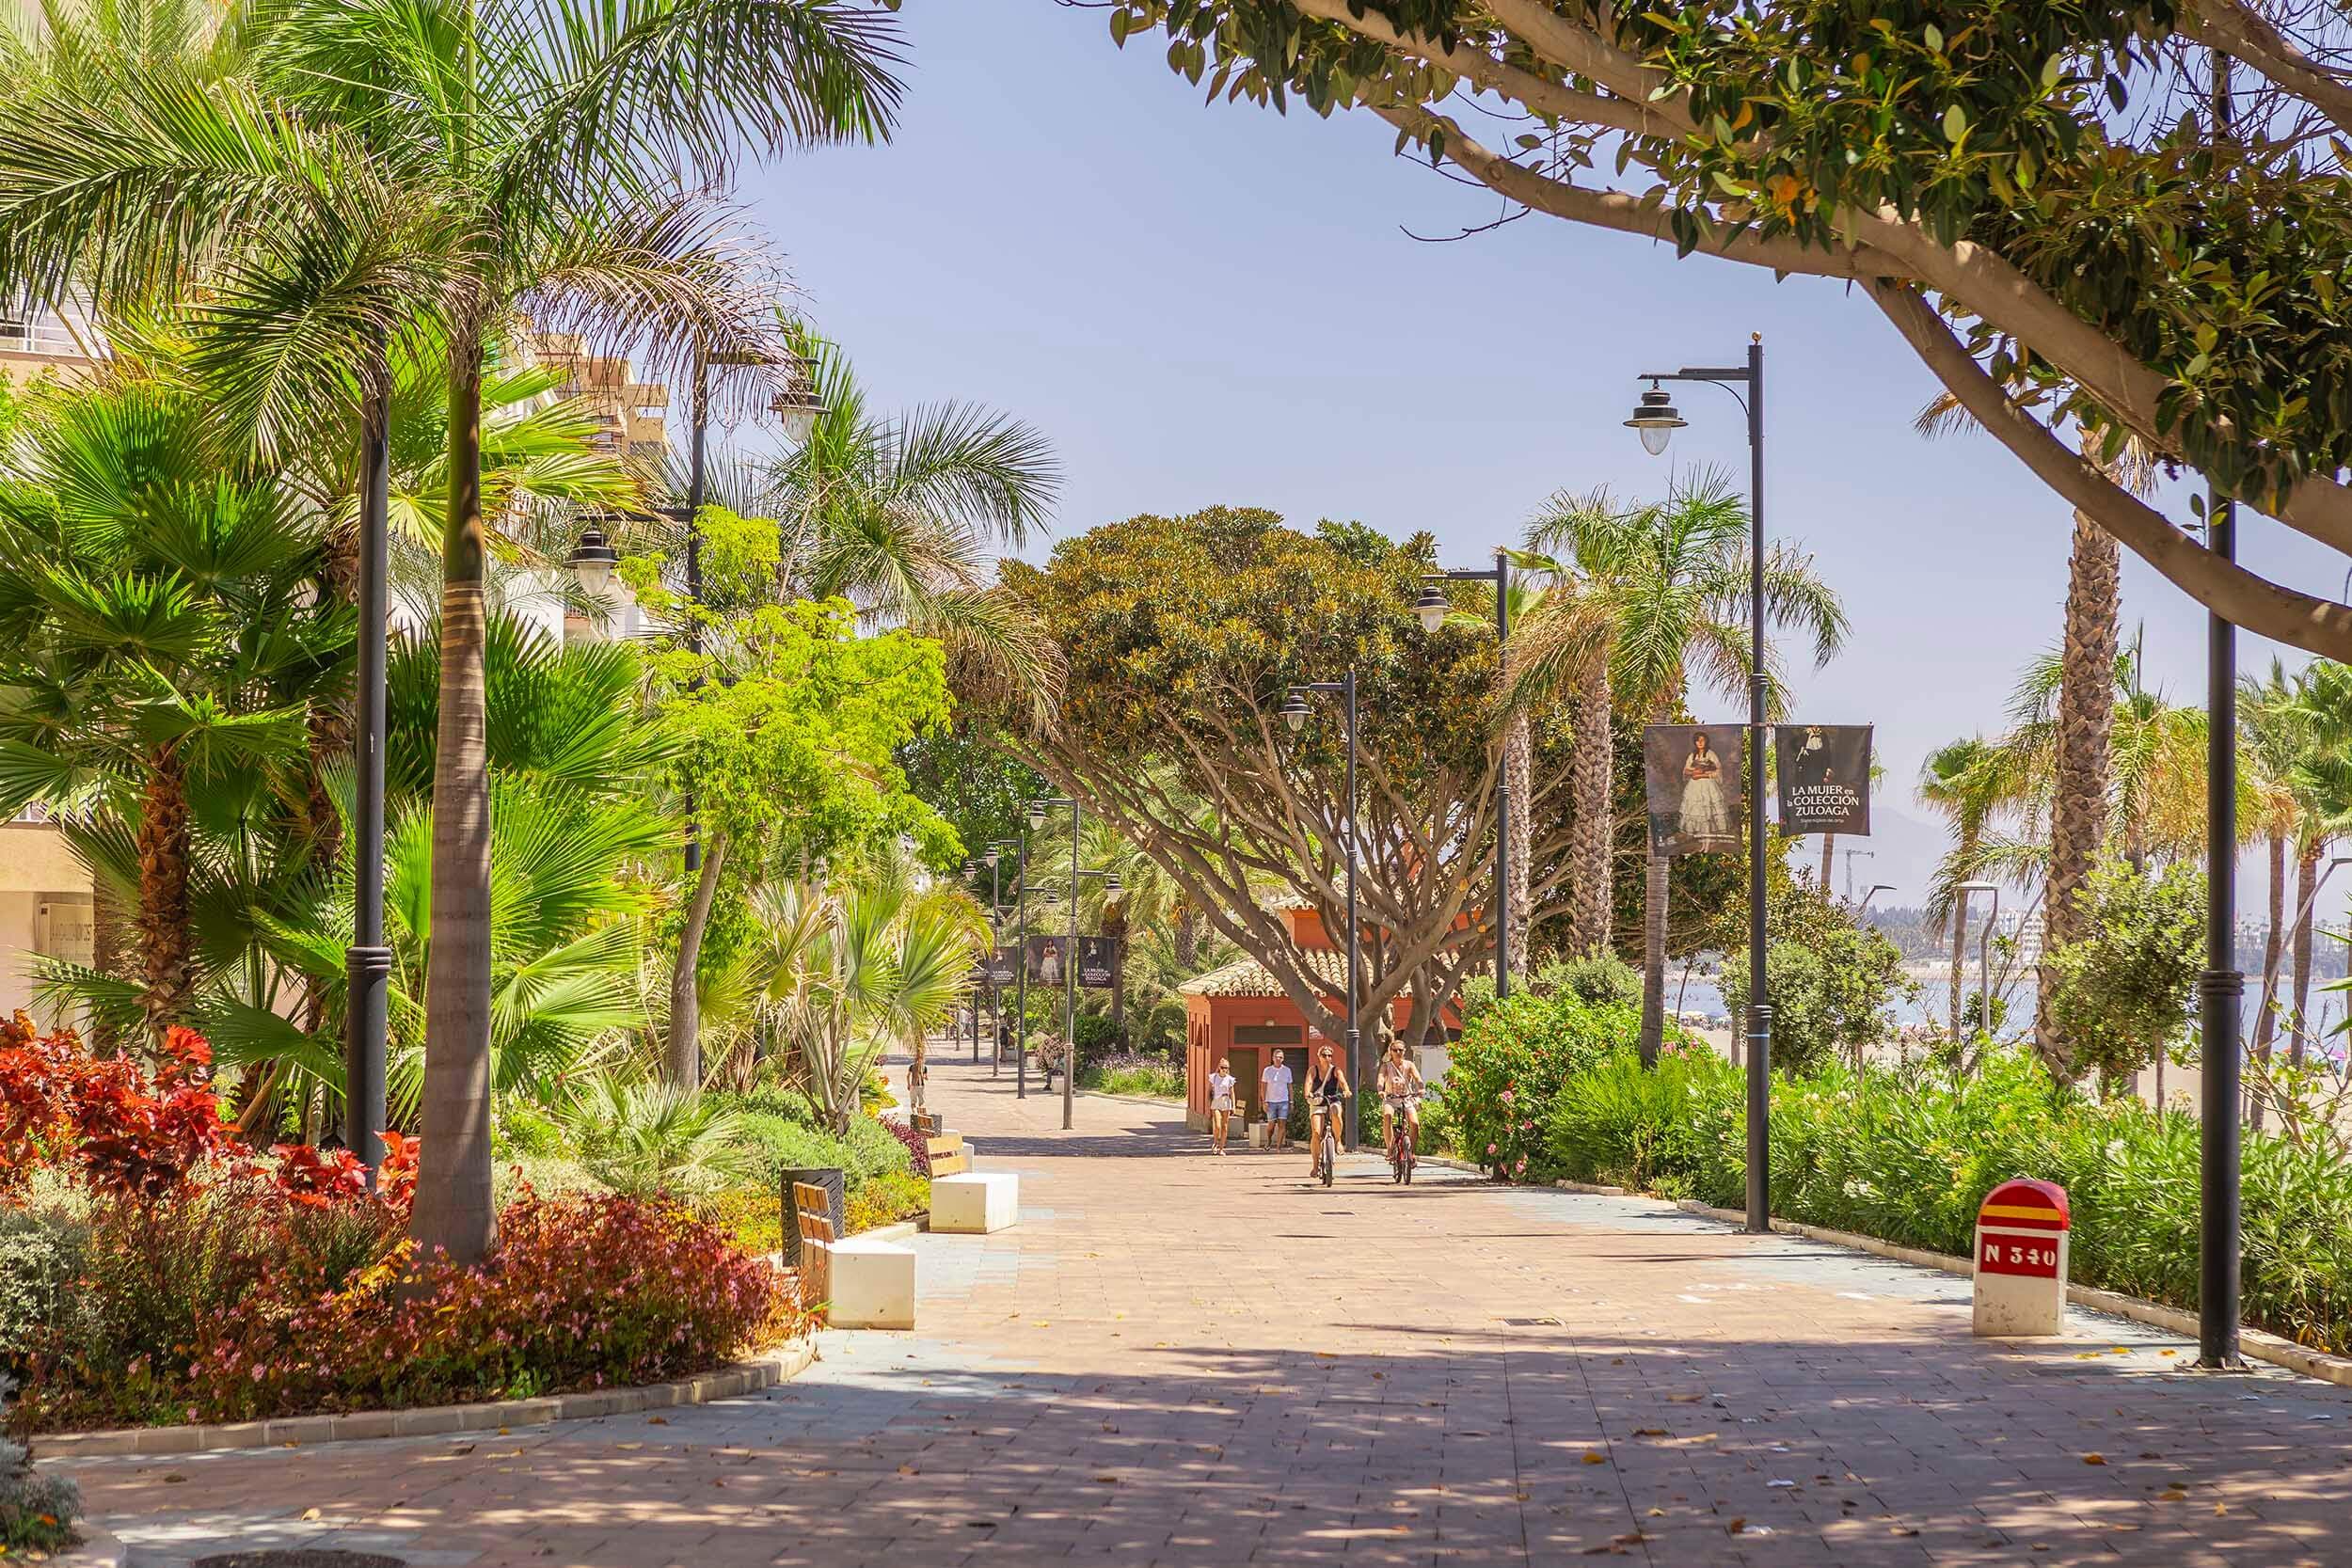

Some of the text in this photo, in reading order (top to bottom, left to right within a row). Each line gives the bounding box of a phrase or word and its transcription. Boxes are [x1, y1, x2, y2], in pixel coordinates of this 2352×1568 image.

[1792, 785, 1805, 796] LA
[1807, 784, 1843, 796] MUJER
[1793, 794, 1859, 806] COLECCIÓN
[1795, 805, 1850, 816] ZULOAGA
[1985, 1243, 2057, 1266] N 340
